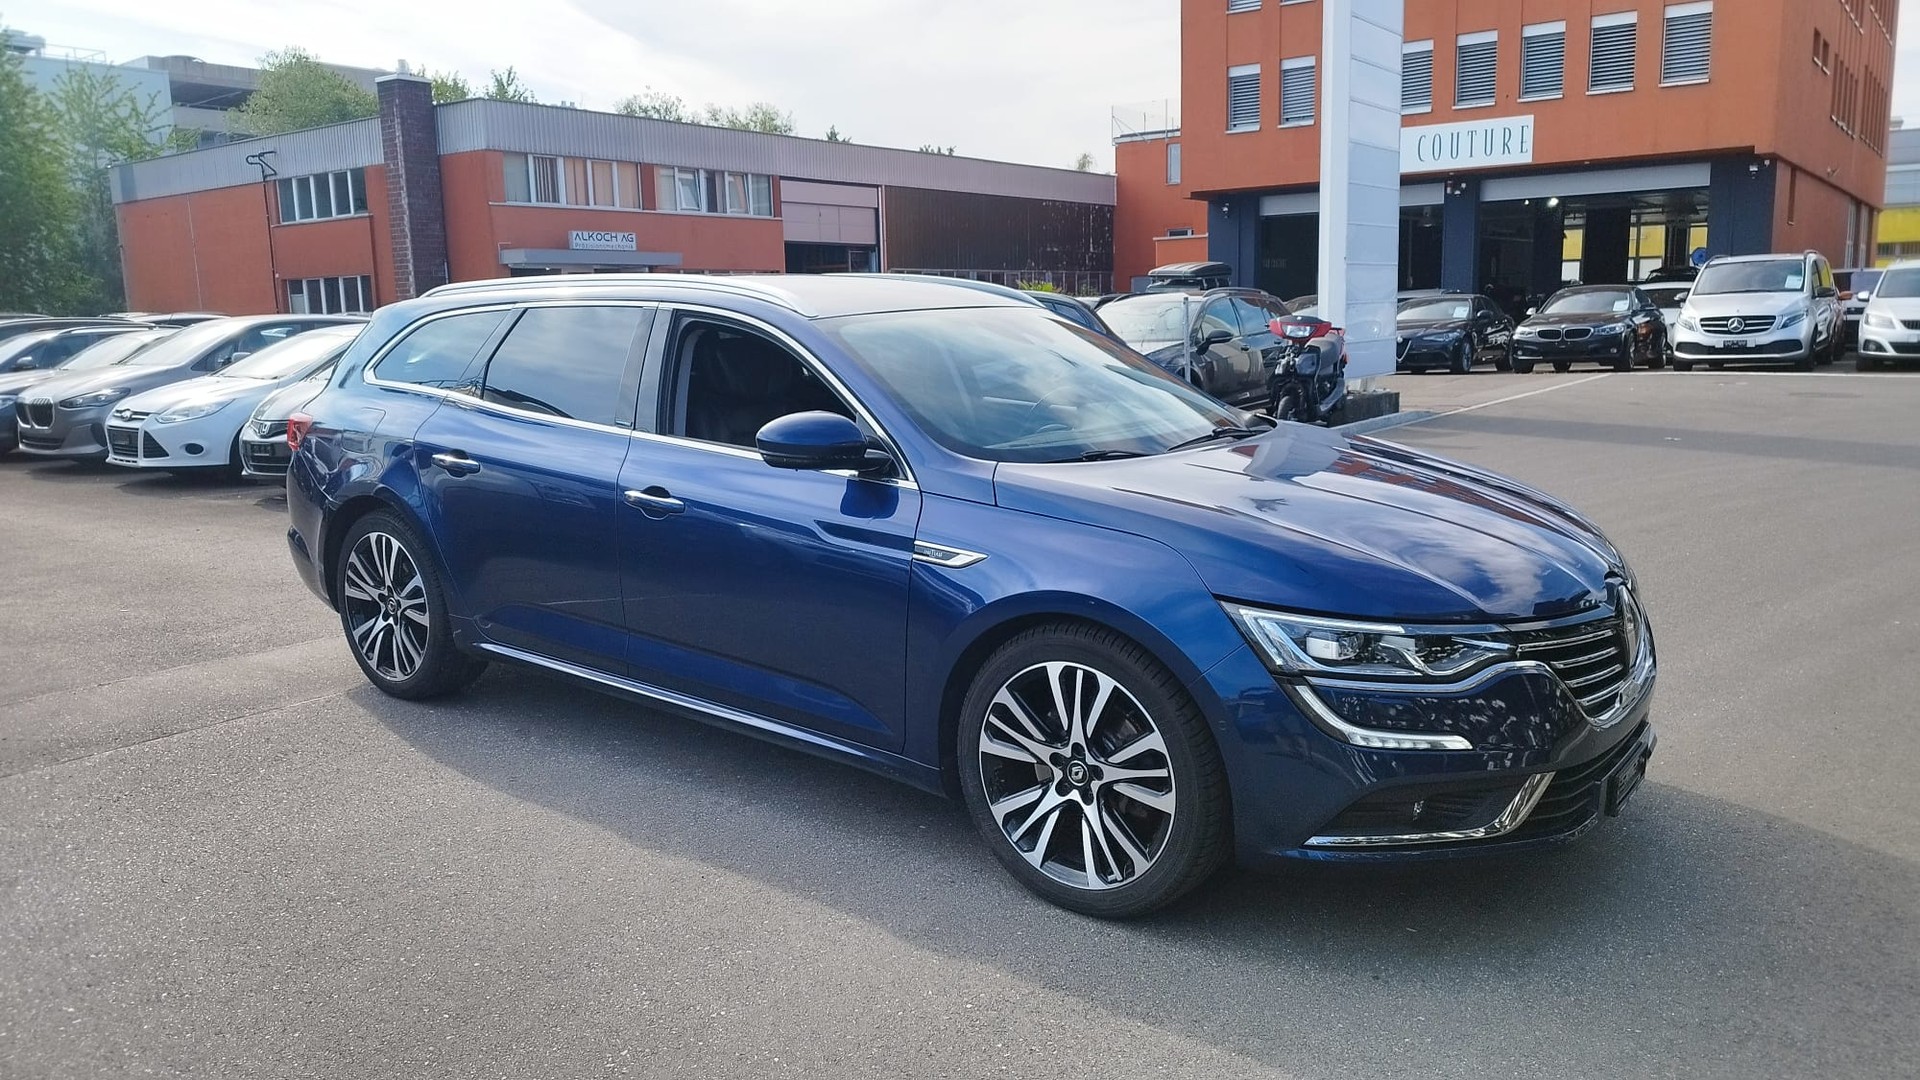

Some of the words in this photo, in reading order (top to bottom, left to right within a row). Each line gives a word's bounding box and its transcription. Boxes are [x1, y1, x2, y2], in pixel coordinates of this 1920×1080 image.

[1417, 125, 1529, 162] COUTURE
[574, 232, 618, 242] ALKOCH
[621, 233, 634, 243] AG
